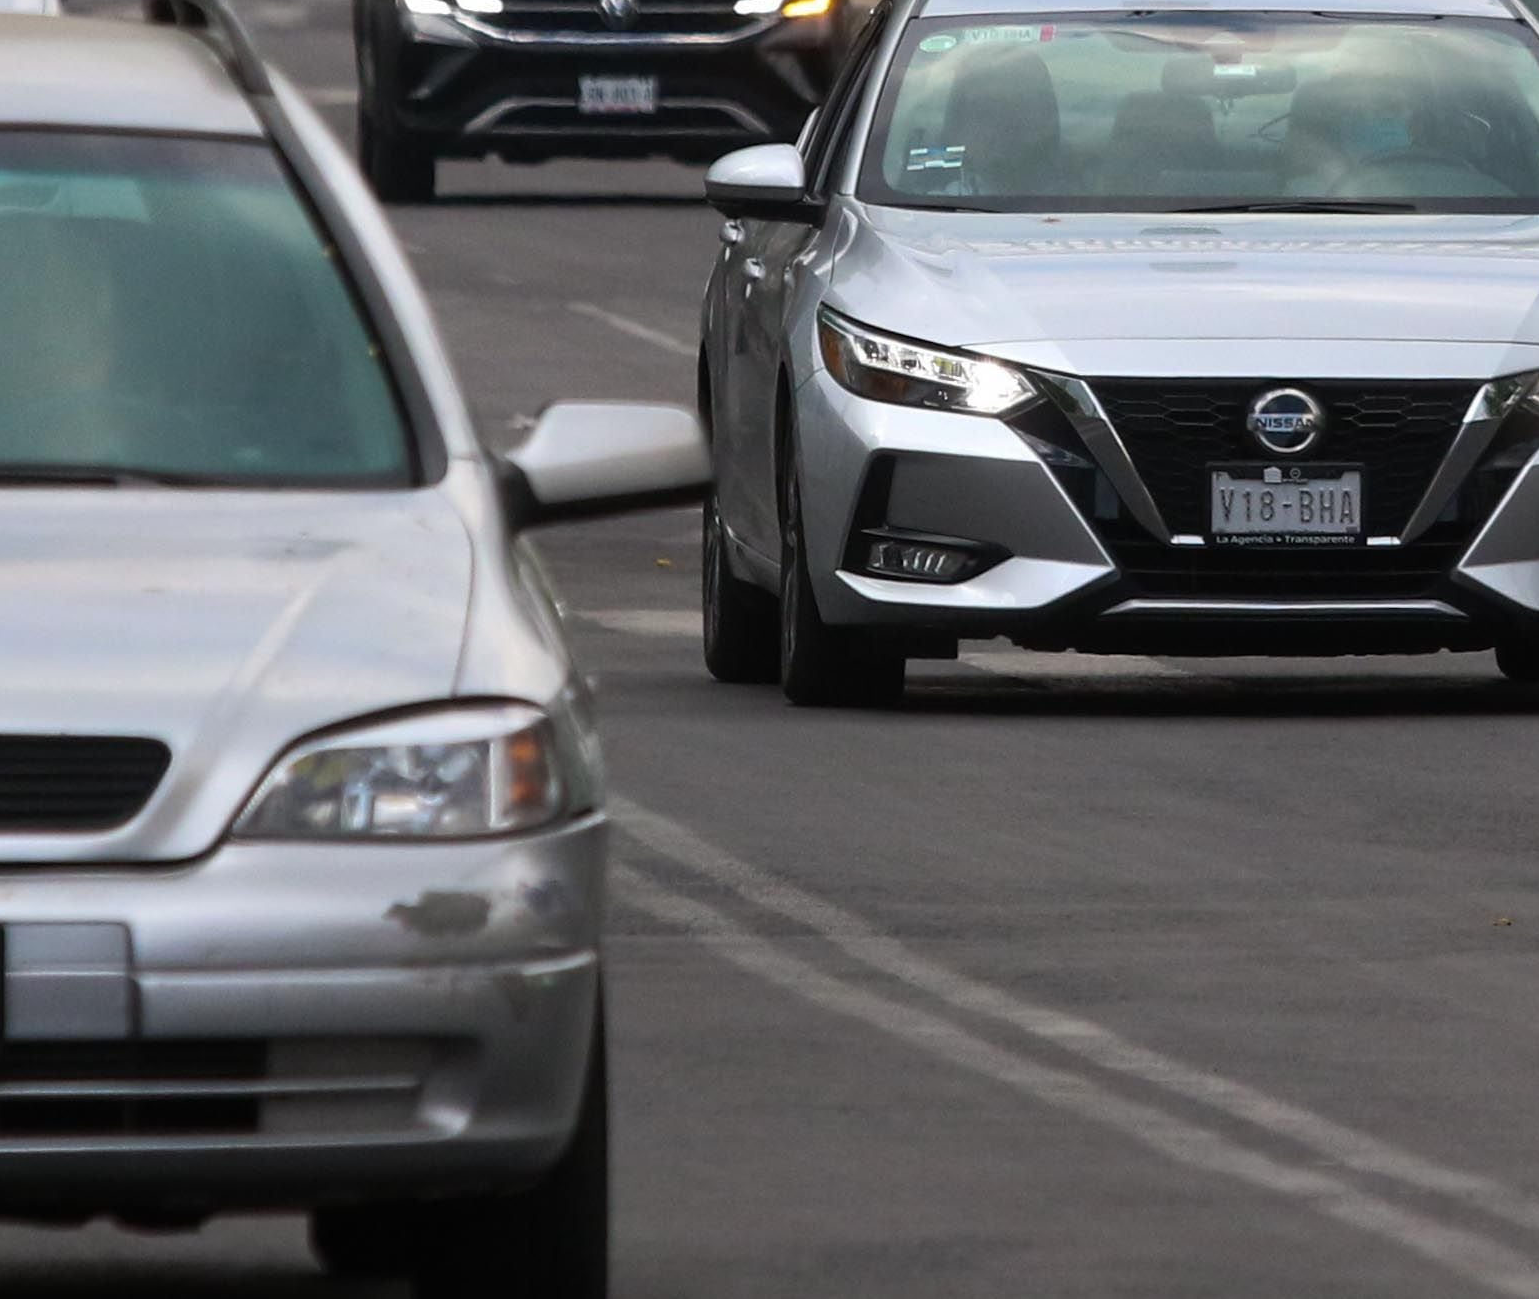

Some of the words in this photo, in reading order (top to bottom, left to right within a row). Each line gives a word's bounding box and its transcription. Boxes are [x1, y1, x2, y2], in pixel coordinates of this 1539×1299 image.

[1254, 416, 1315, 430] NISSAN
[1219, 488, 1355, 524] V18-BHA
[1216, 536, 1229, 544] La
[1230, 535, 1274, 546] Agencia
[1284, 535, 1355, 545] Transparente
